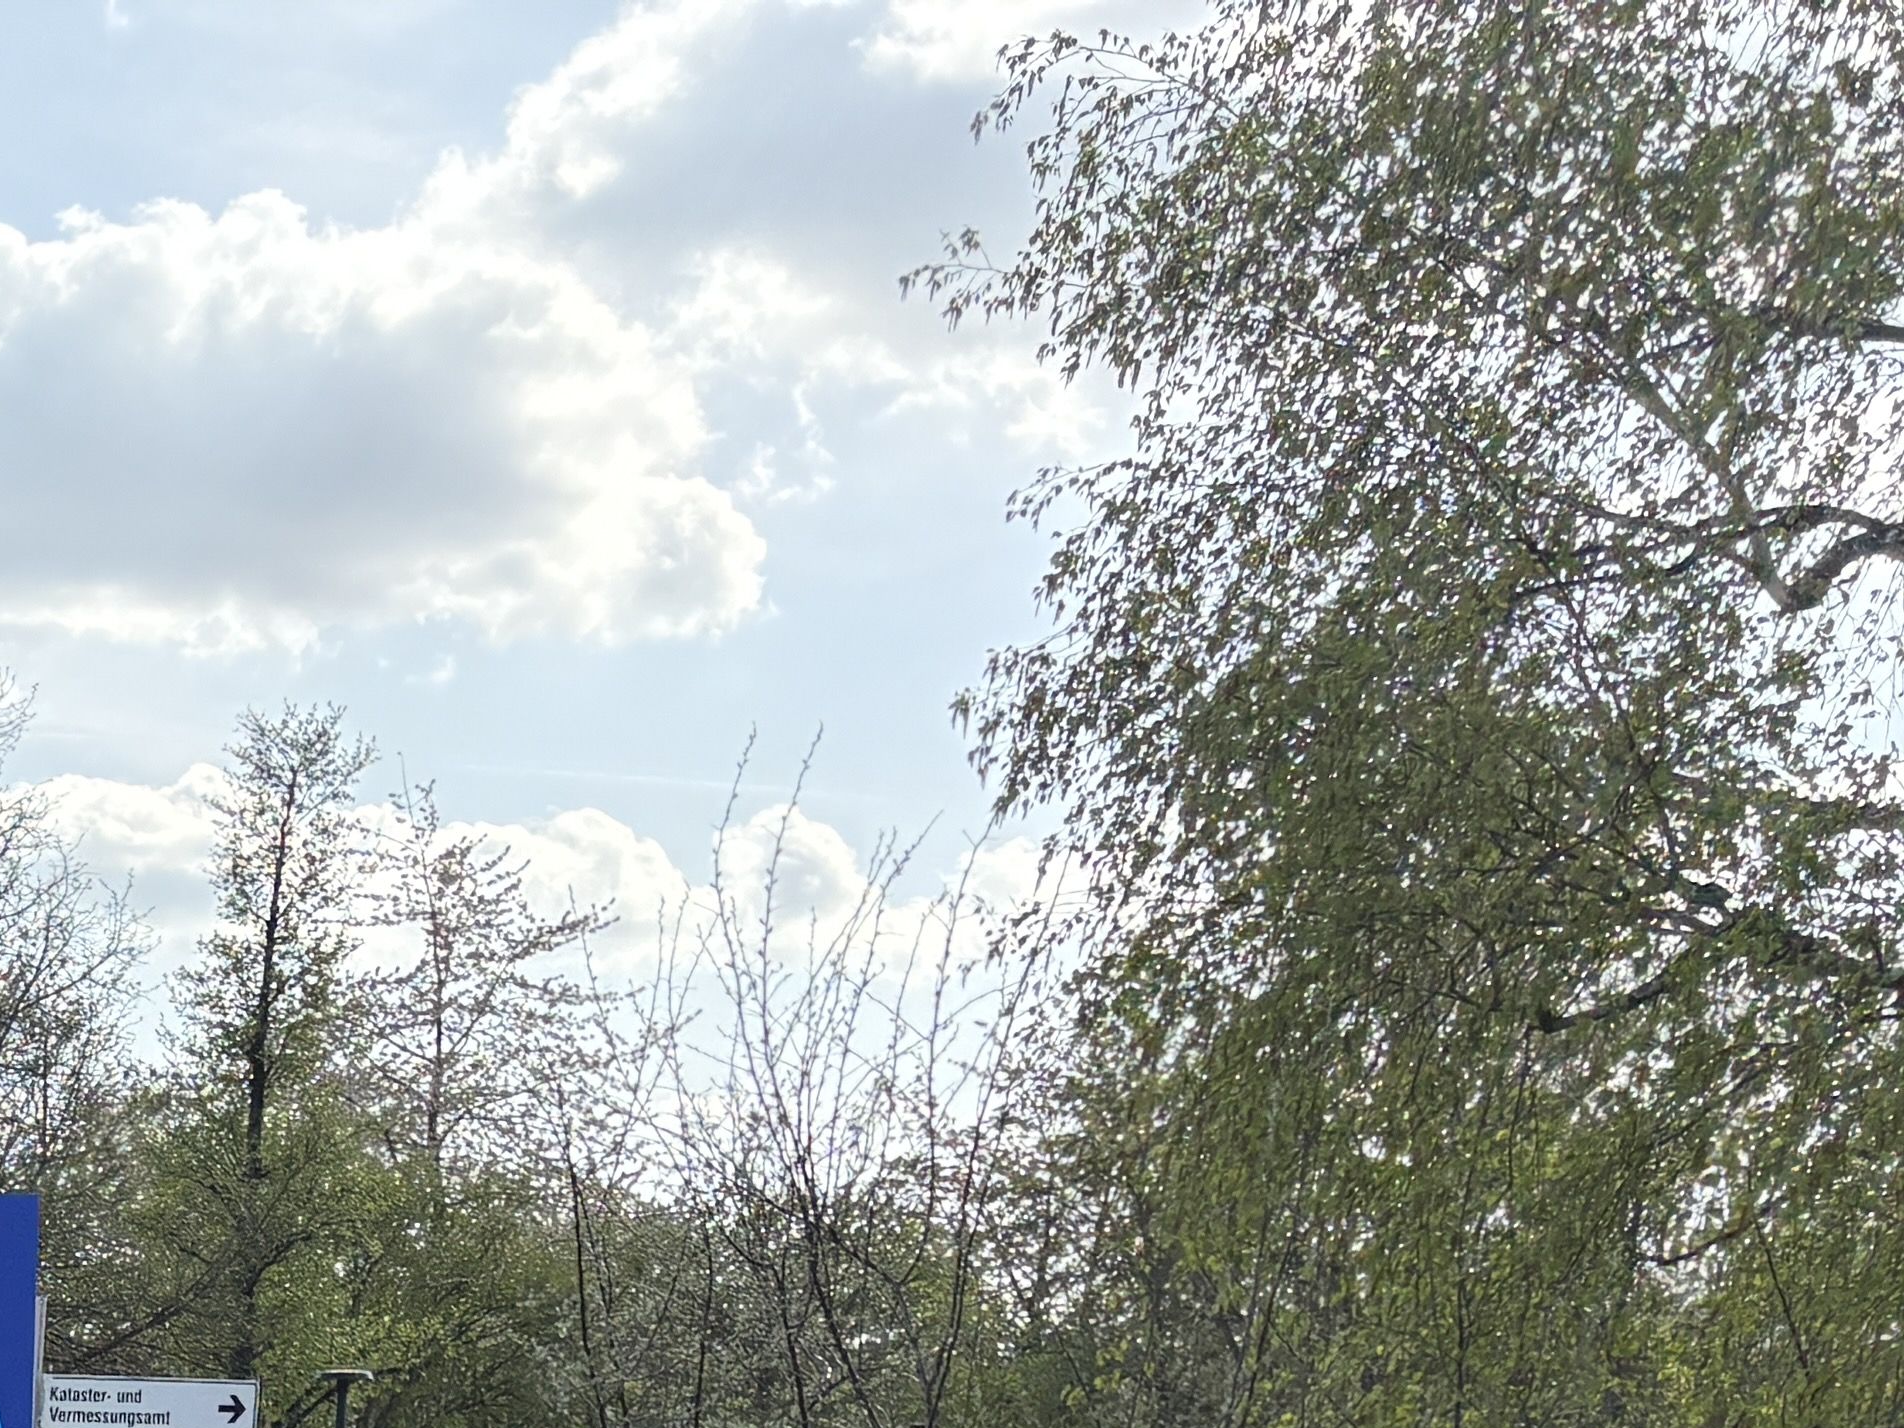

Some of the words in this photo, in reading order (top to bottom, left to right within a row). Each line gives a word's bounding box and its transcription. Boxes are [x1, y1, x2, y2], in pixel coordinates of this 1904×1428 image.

[49, 1386, 111, 1402] Kataster-
[117, 1389, 142, 1403] und
[49, 1406, 171, 1427] Vermessungsamt
